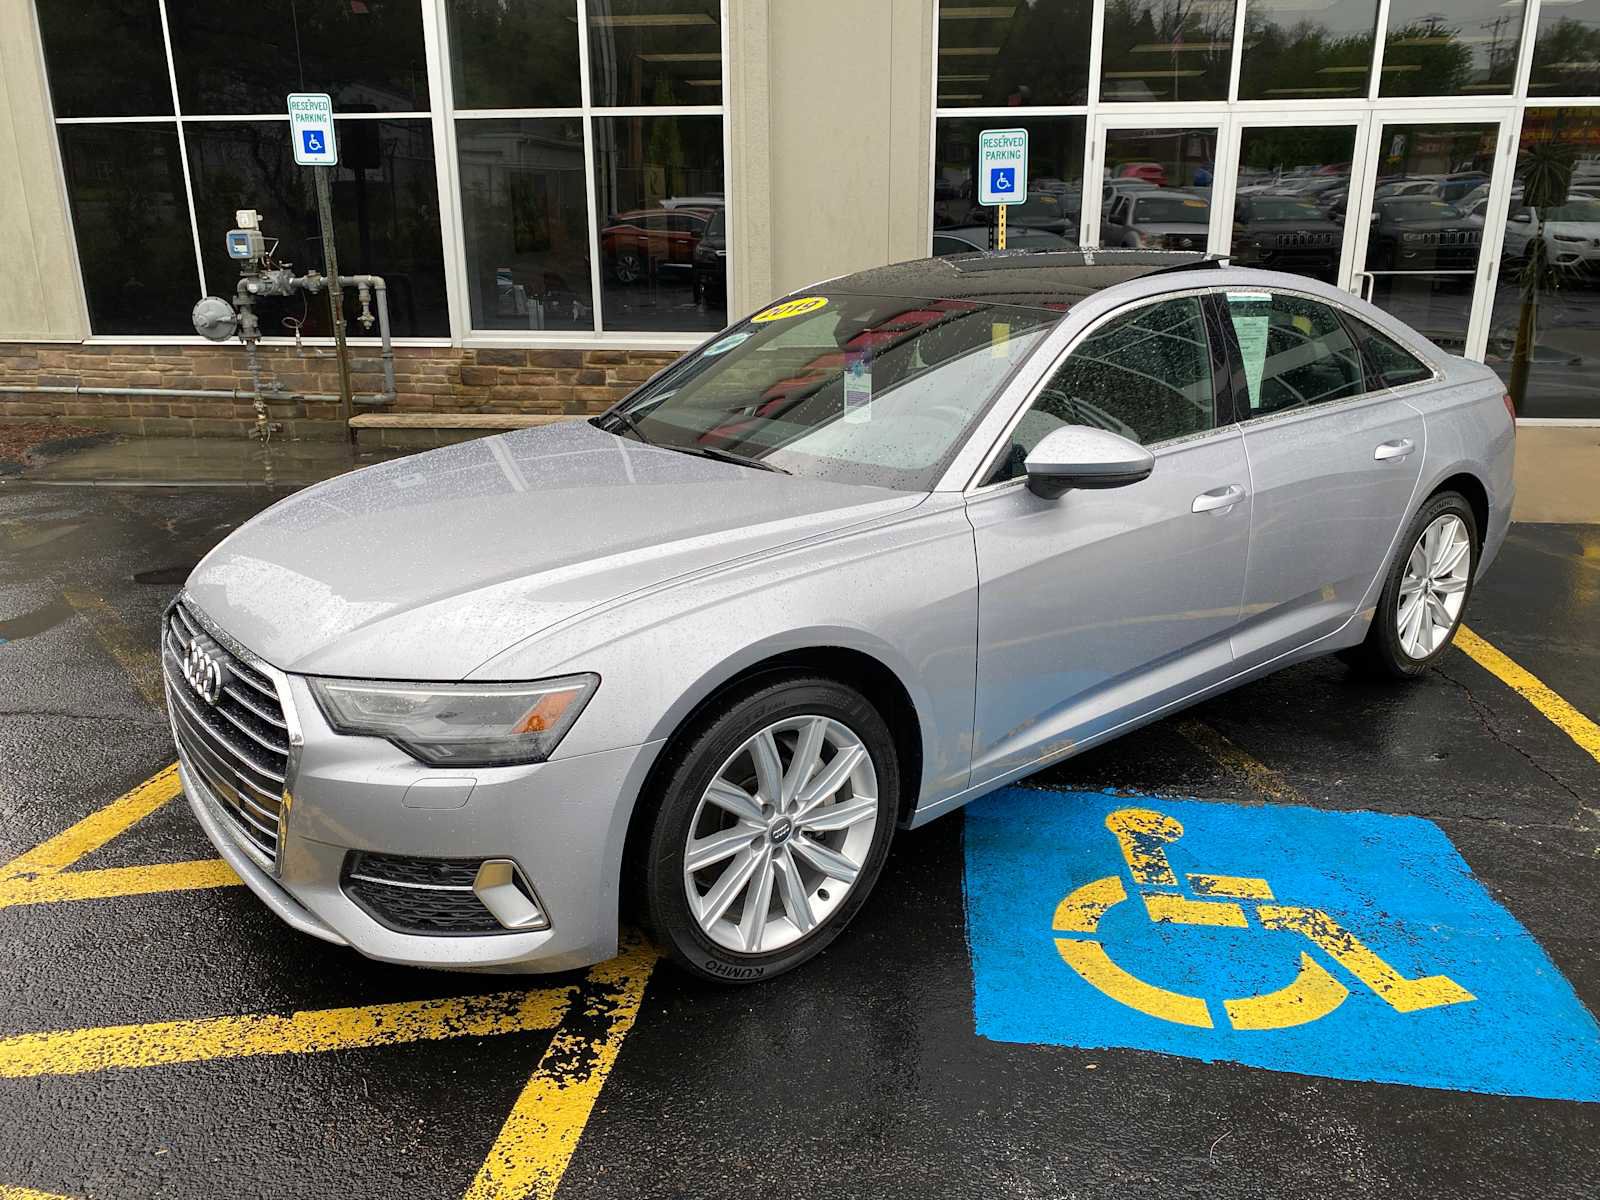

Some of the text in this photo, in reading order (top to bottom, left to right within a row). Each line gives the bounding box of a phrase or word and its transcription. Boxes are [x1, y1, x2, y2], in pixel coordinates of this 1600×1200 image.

[290, 101, 328, 111] RESERVED
[295, 113, 327, 122] PARKING
[983, 137, 1024, 148] RESERVED
[986, 150, 1021, 160] PARKING
[705, 960, 765, 978] KUMHO
